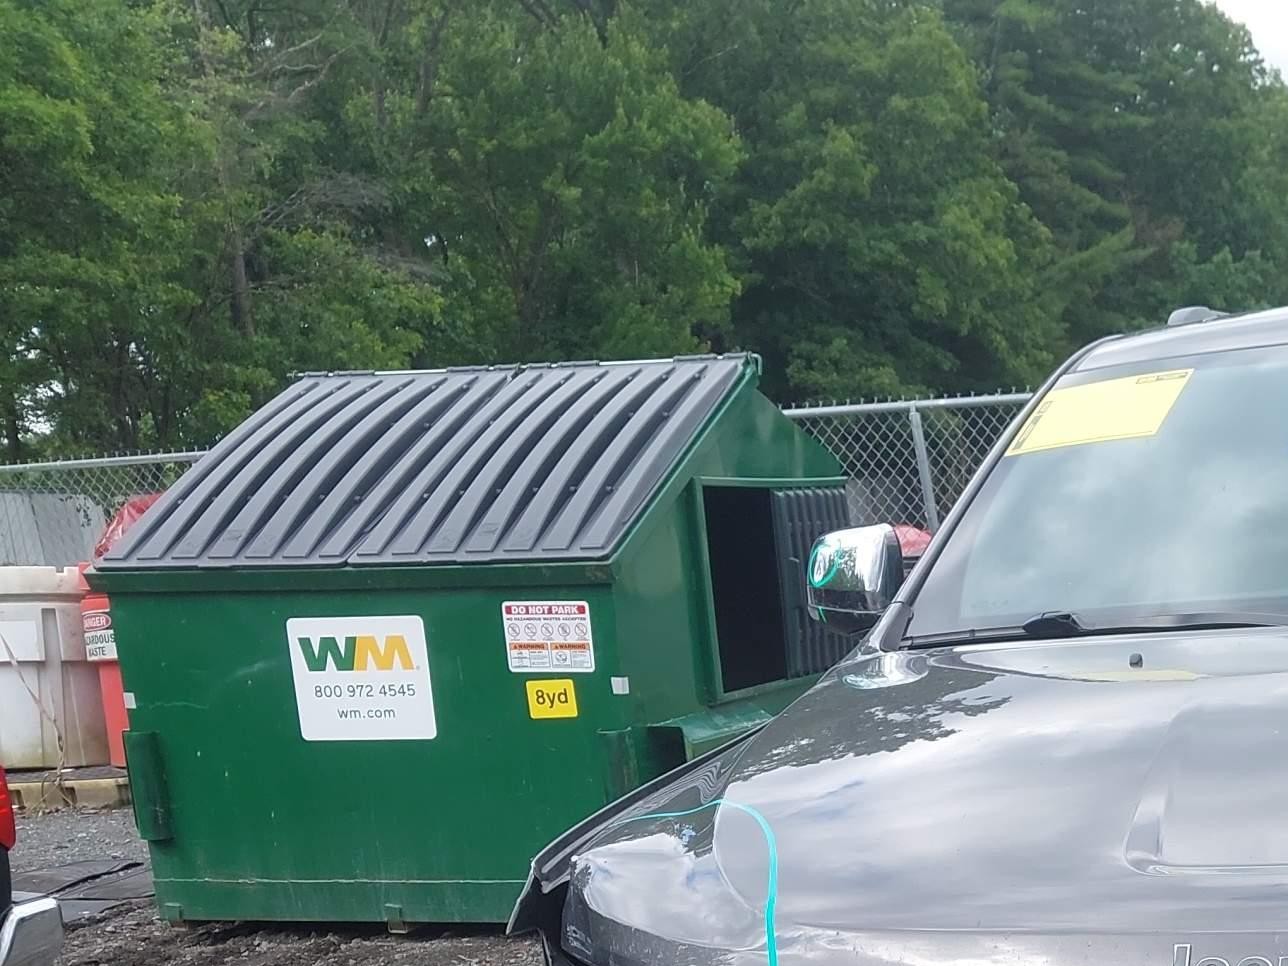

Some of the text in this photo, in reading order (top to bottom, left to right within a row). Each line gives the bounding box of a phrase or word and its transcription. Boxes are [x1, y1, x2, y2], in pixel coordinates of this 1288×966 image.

[511, 605, 579, 615] DO NOT PARK
[297, 635, 415, 672] WM
[314, 683, 416, 698] 800 972 4545
[535, 688, 568, 709] 8yd
[337, 708, 396, 720] wm.com
